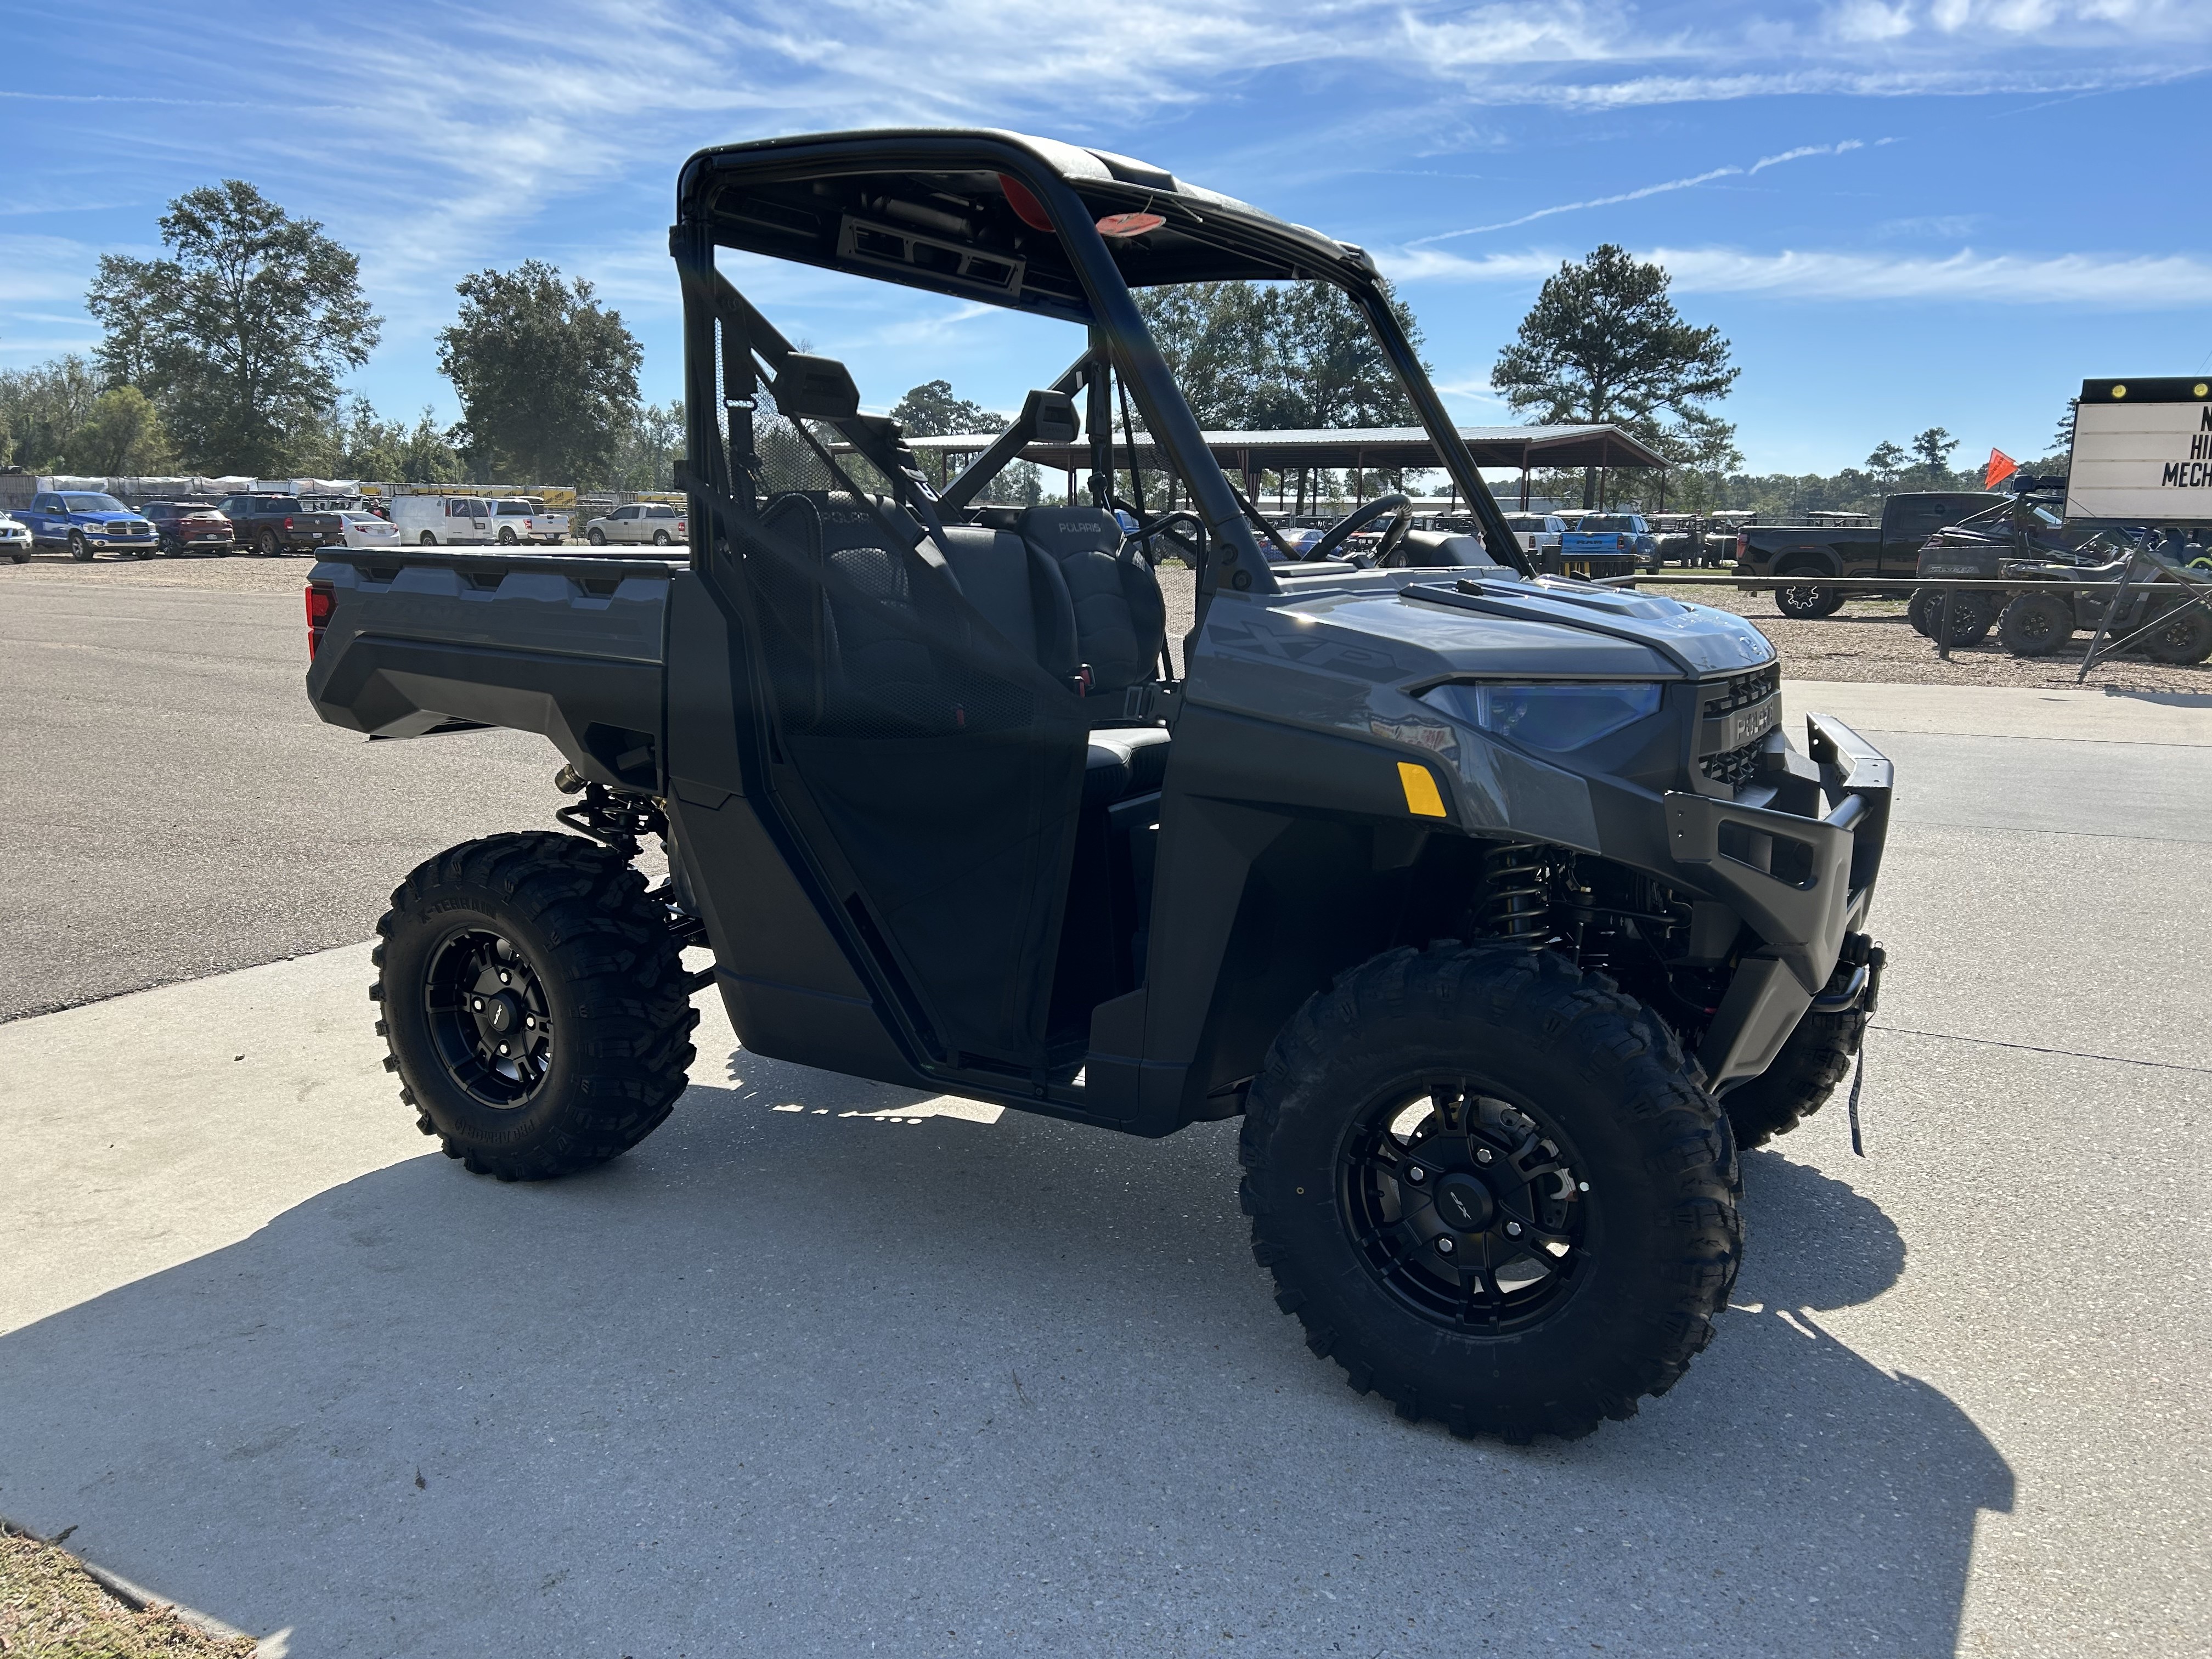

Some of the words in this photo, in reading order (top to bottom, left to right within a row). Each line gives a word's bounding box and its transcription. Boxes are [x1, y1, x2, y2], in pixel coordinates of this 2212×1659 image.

[2162, 462, 2212, 487] MECH
[1058, 522, 1101, 533] POLARIS
[417, 898, 496, 925] X-TERRAIN
